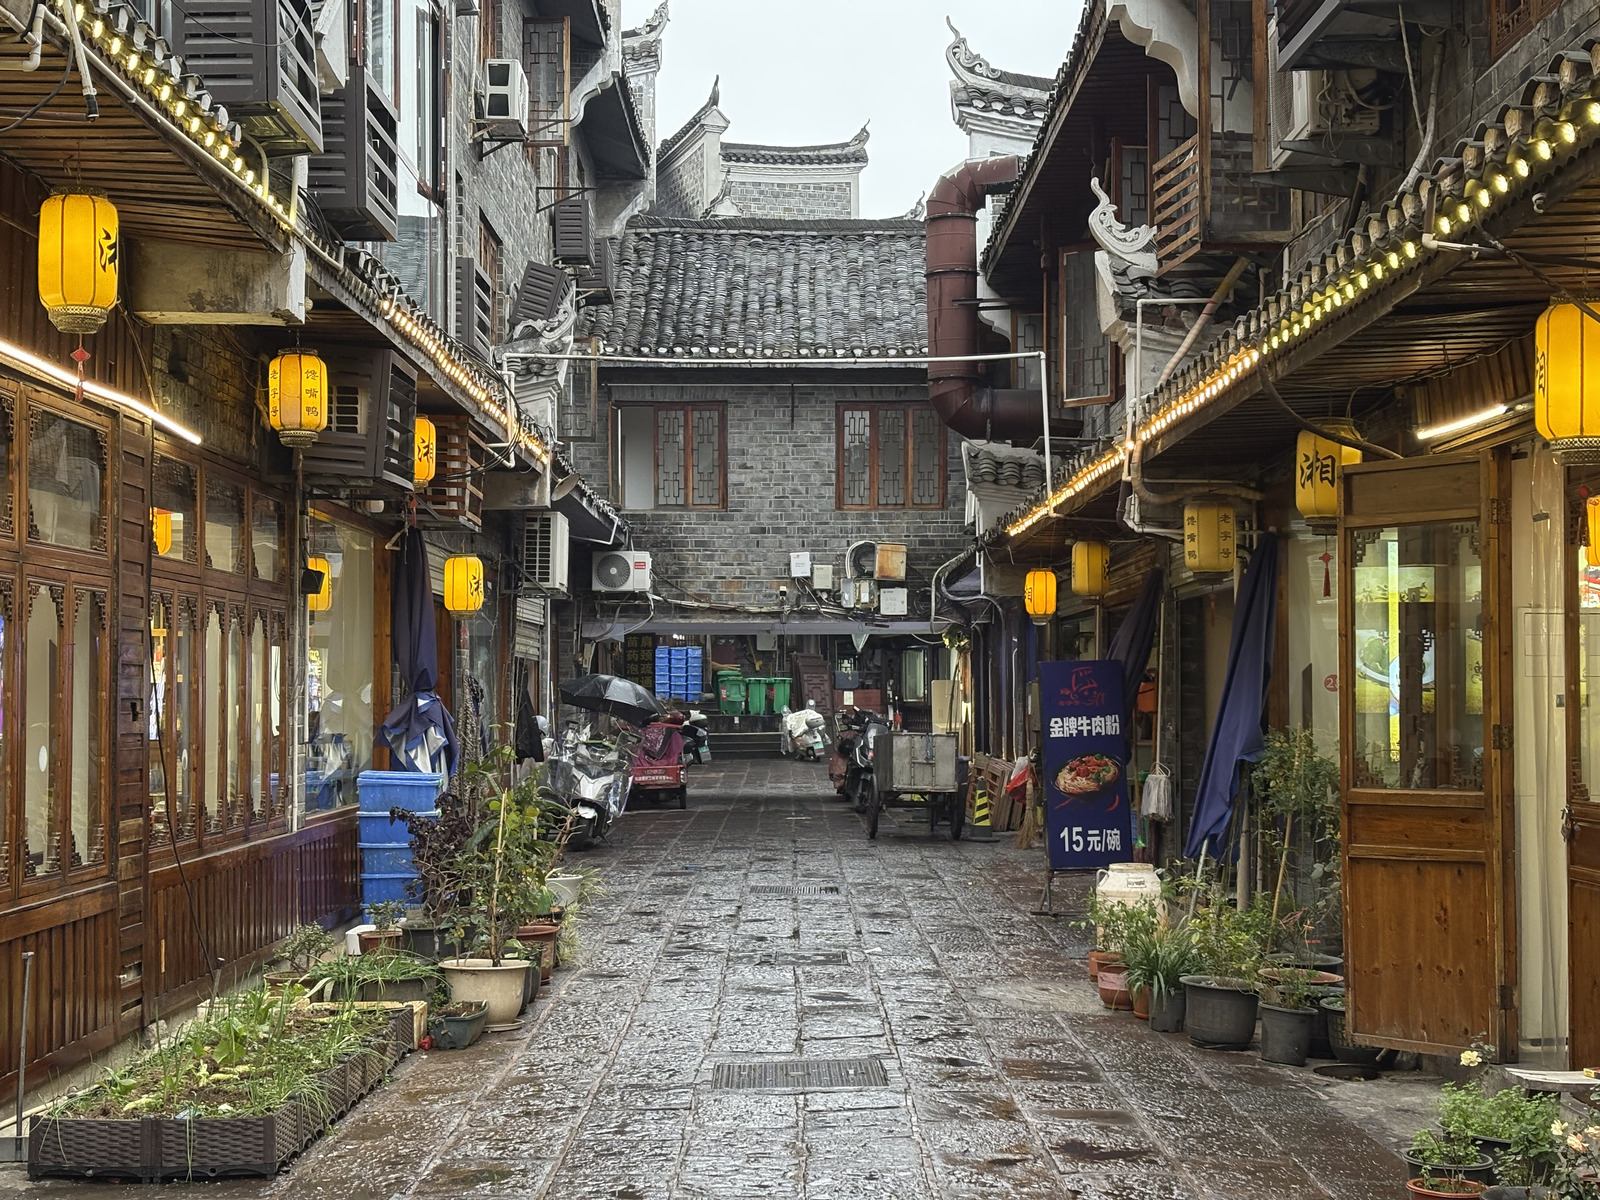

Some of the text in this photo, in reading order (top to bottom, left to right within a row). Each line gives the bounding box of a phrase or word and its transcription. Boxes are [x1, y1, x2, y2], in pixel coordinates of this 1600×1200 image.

[270, 368, 278, 417] 老字号
[304, 368, 319, 417] 馋嘴鸭
[1300, 449, 1336, 490] 湘
[1186, 515, 1197, 560] 馋嘴鸭
[1219, 513, 1232, 559] 老字号
[1049, 714, 1120, 738] 金牌牛肉粉
